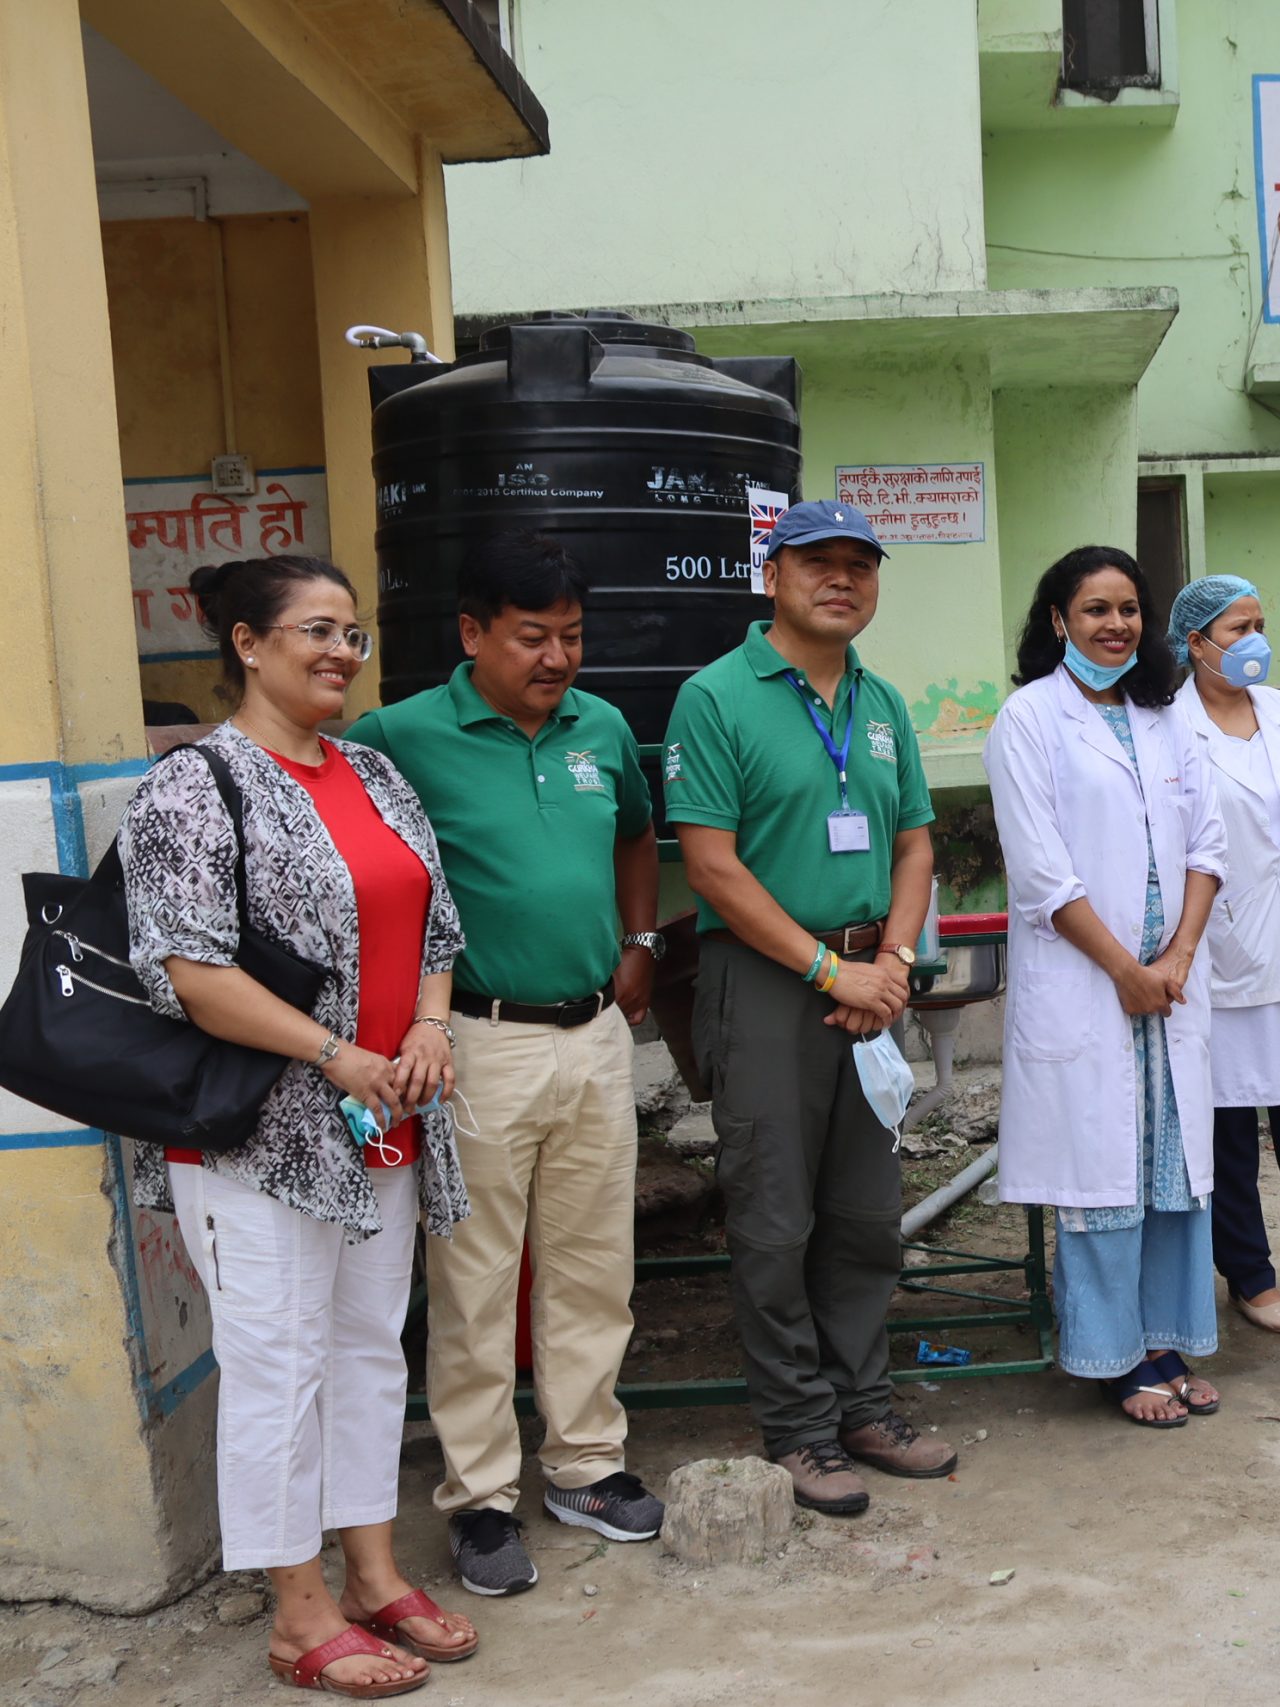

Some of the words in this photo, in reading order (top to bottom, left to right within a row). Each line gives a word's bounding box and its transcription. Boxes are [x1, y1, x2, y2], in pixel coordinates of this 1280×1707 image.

[930, 467, 954, 485] लागि
[502, 487, 548, 497] Certified
[550, 488, 604, 499] Company
[127, 493, 250, 554] म्पति
[256, 483, 308, 556] हो
[666, 556, 712, 581] 500
